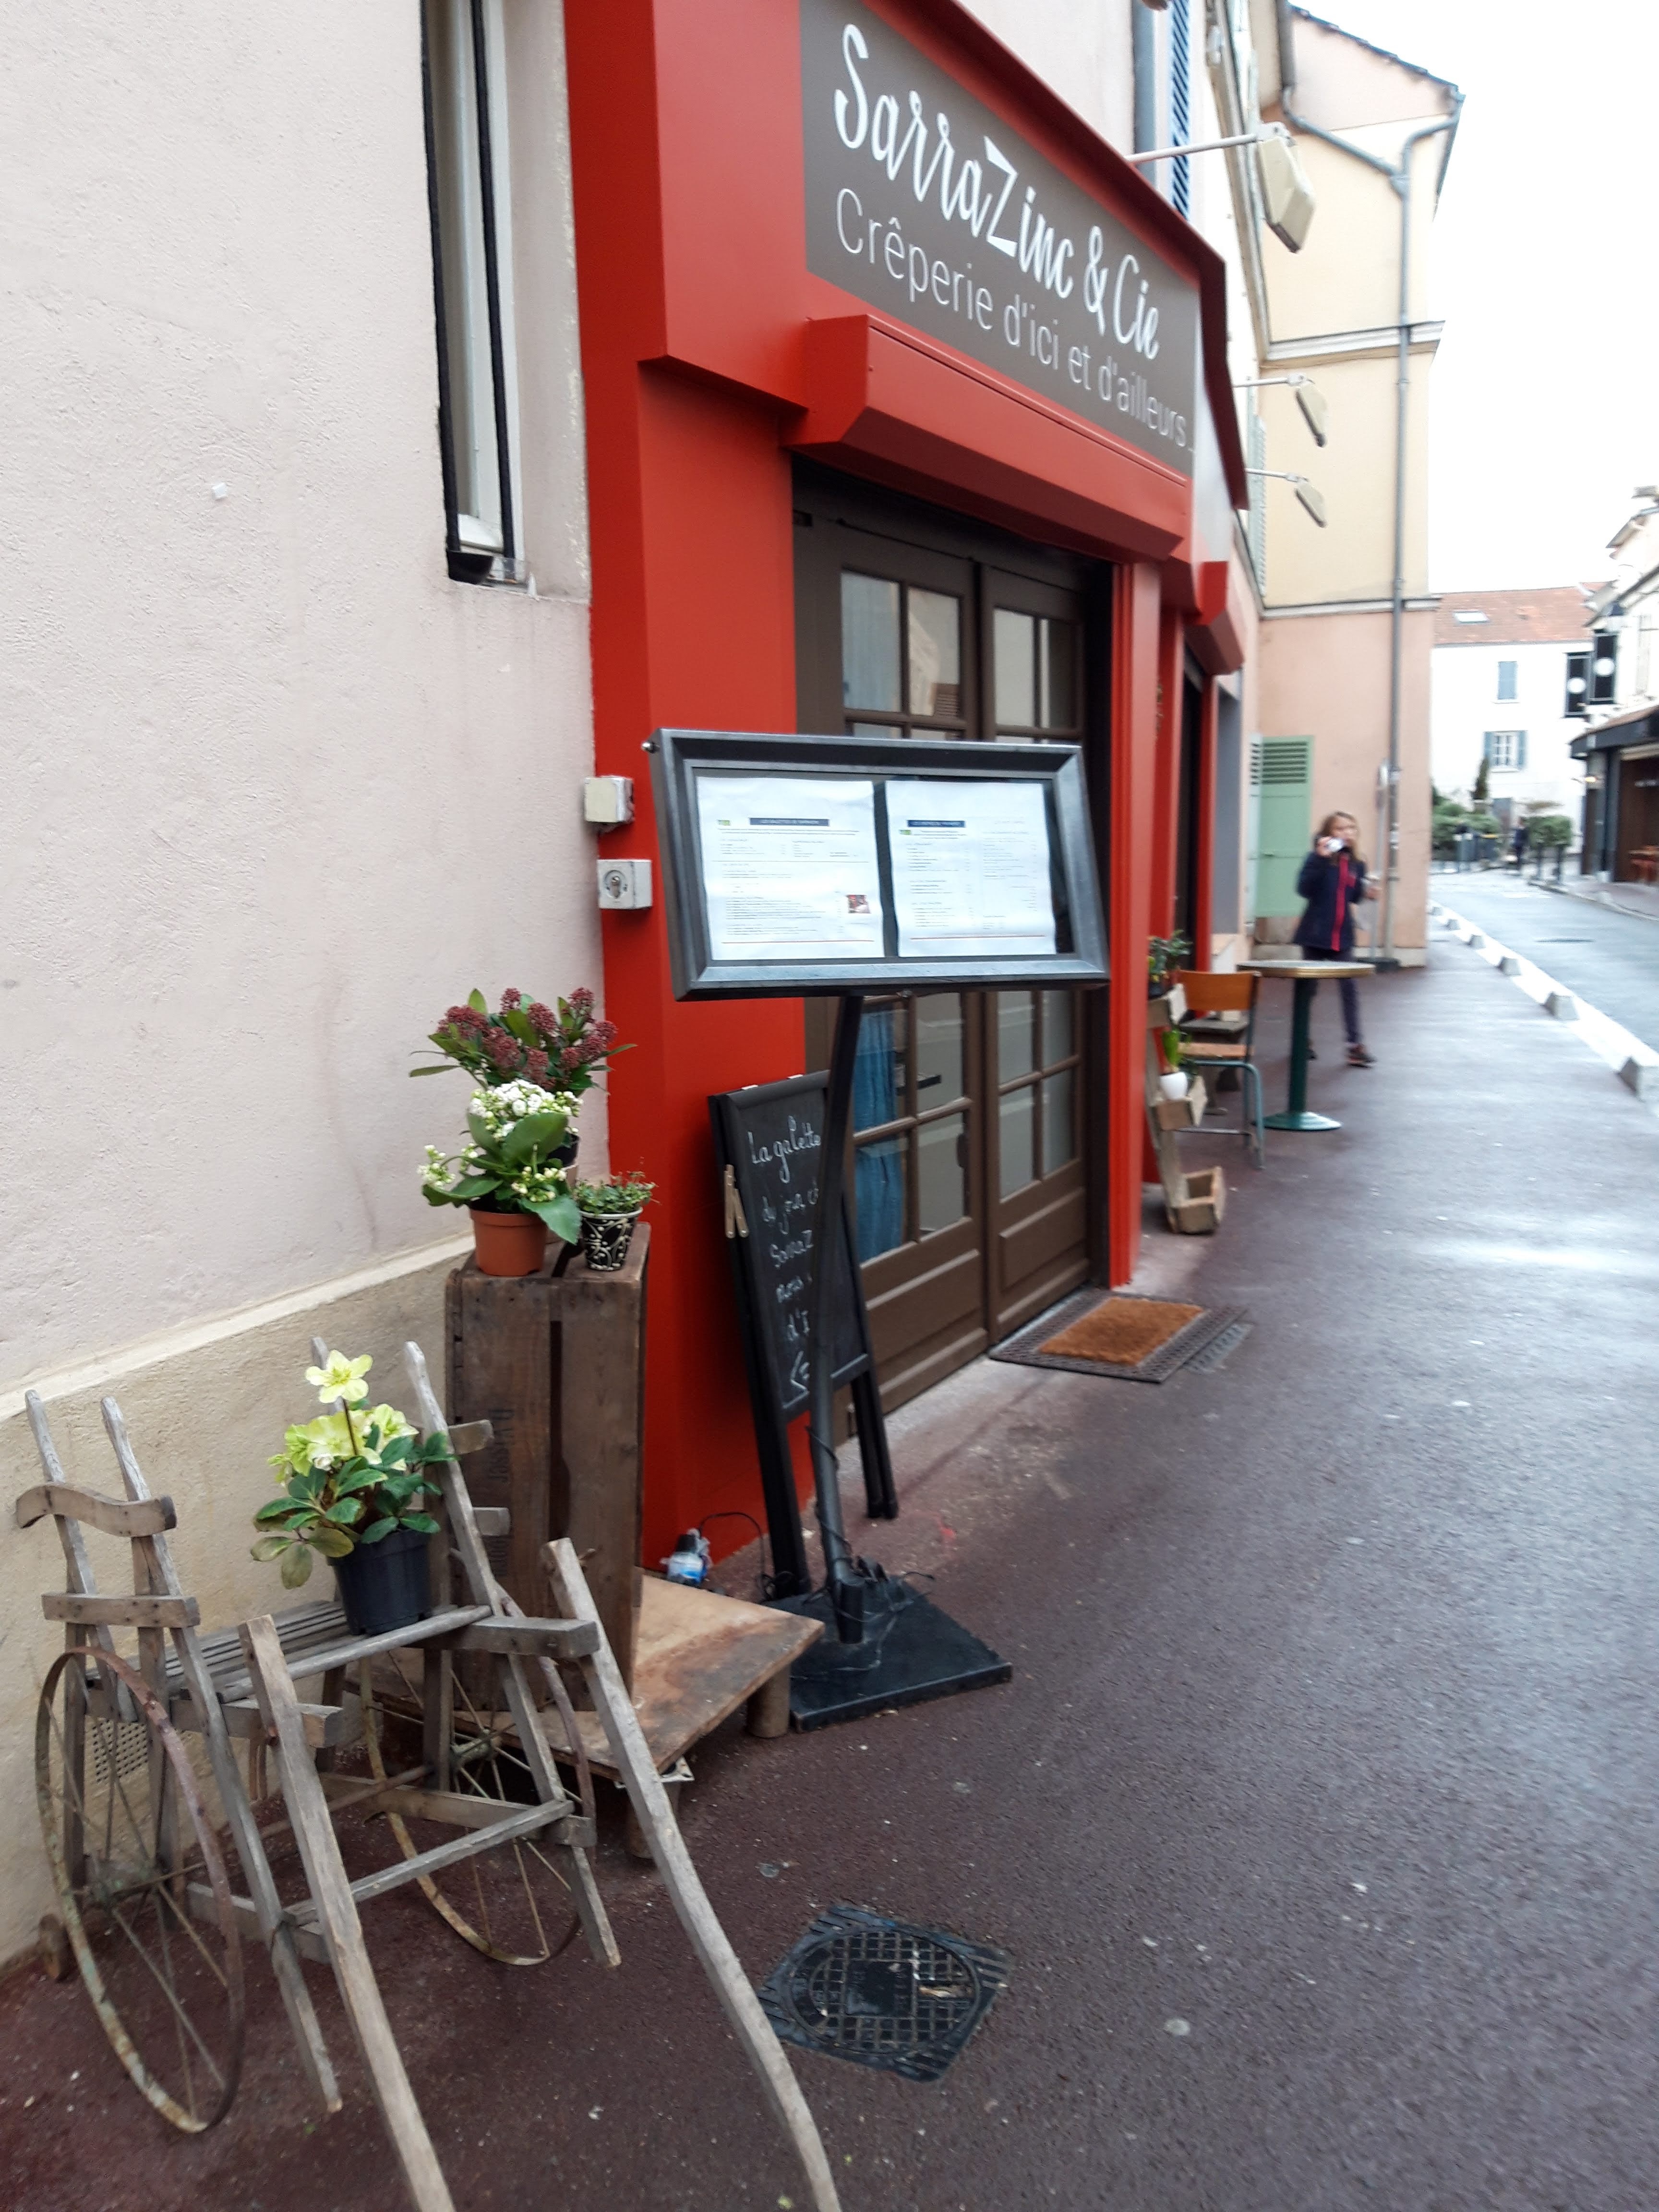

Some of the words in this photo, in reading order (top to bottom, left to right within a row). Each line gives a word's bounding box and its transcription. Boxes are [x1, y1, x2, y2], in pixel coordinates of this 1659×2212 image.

[834, 23, 1074, 300] SarraZinc
[1083, 225, 1109, 335] &
[1112, 254, 1160, 361] Cie
[836, 187, 994, 331] Crêperie
[1004, 294, 1059, 370] d'ici
[1068, 343, 1092, 390] et
[747, 1131, 773, 1164] La
[773, 1115, 822, 1183] galette
